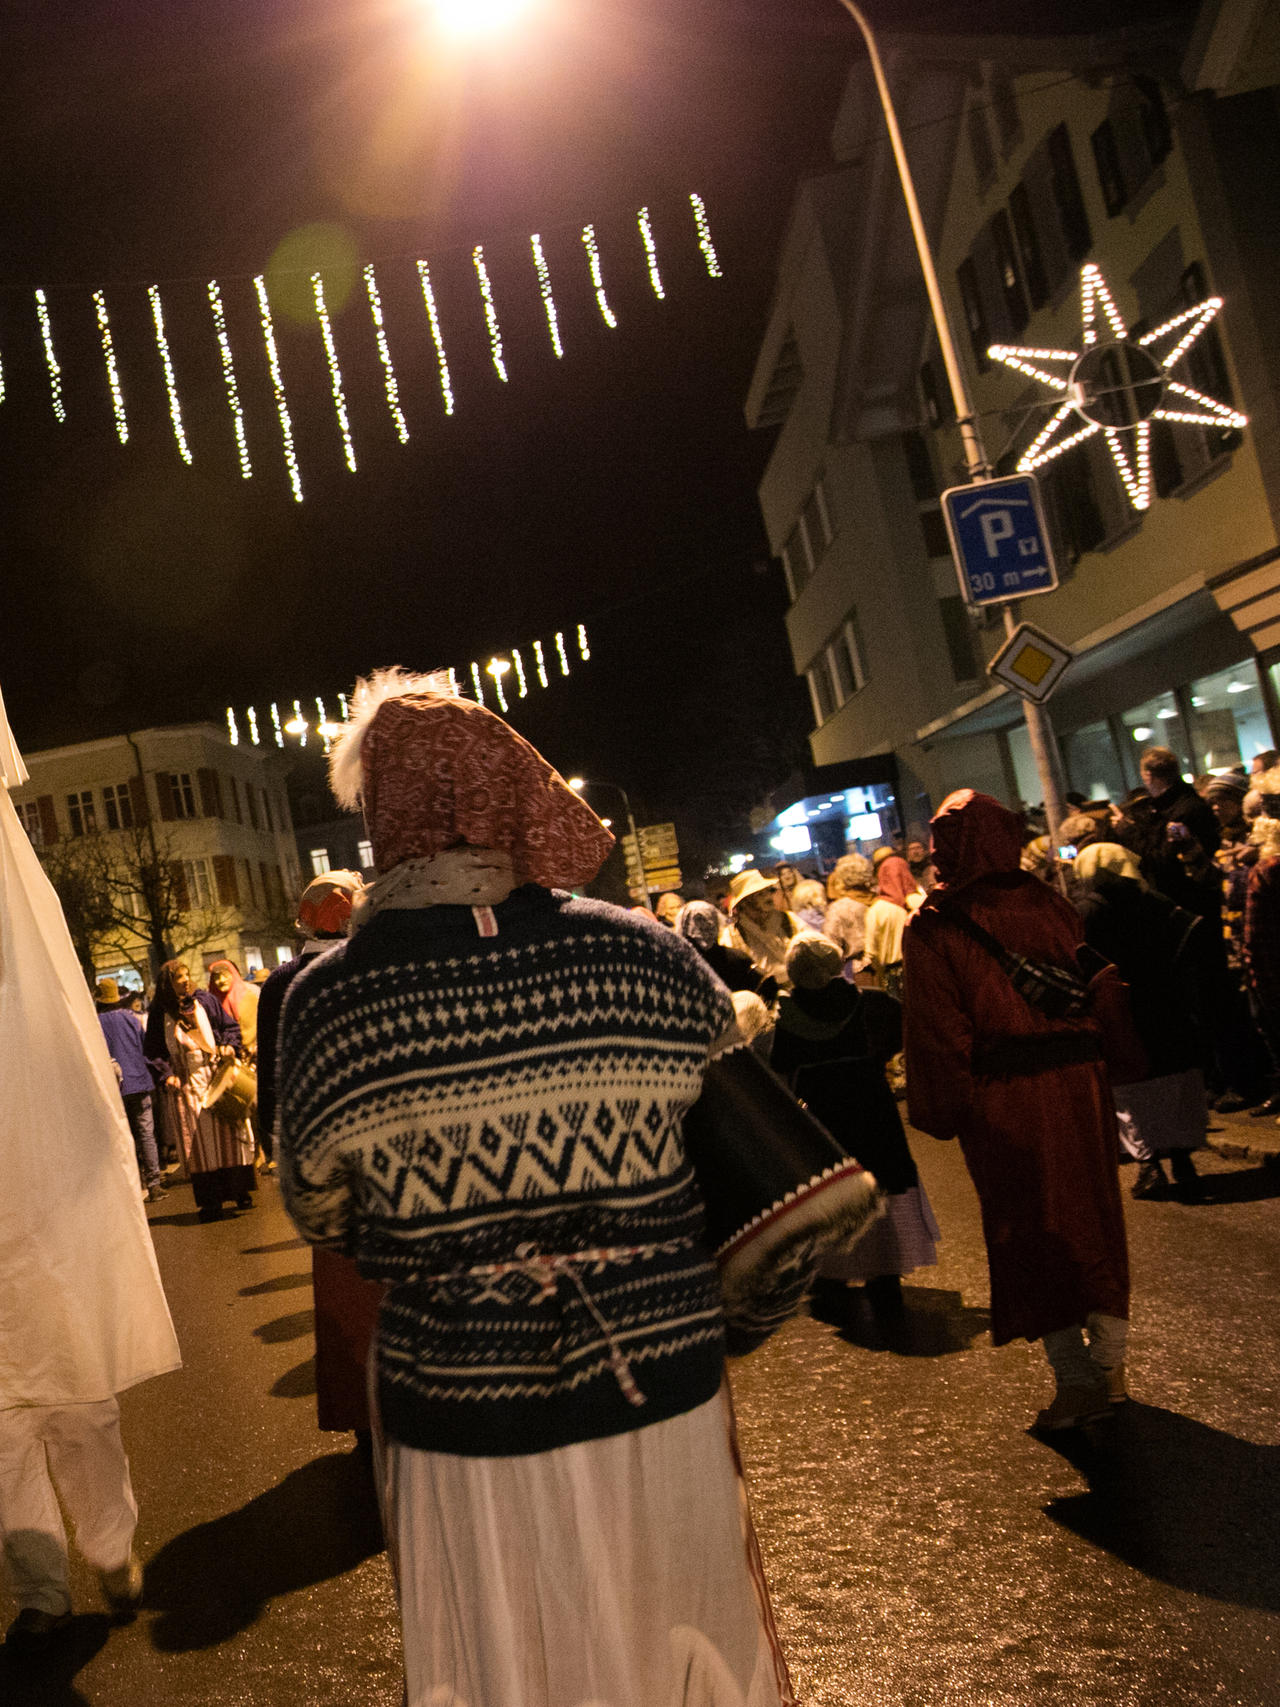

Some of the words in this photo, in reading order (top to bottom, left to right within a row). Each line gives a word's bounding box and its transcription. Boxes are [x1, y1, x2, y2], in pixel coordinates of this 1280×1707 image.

[980, 509, 1015, 559] P
[970, 573, 996, 593] 30
[1003, 569, 1021, 586] m
